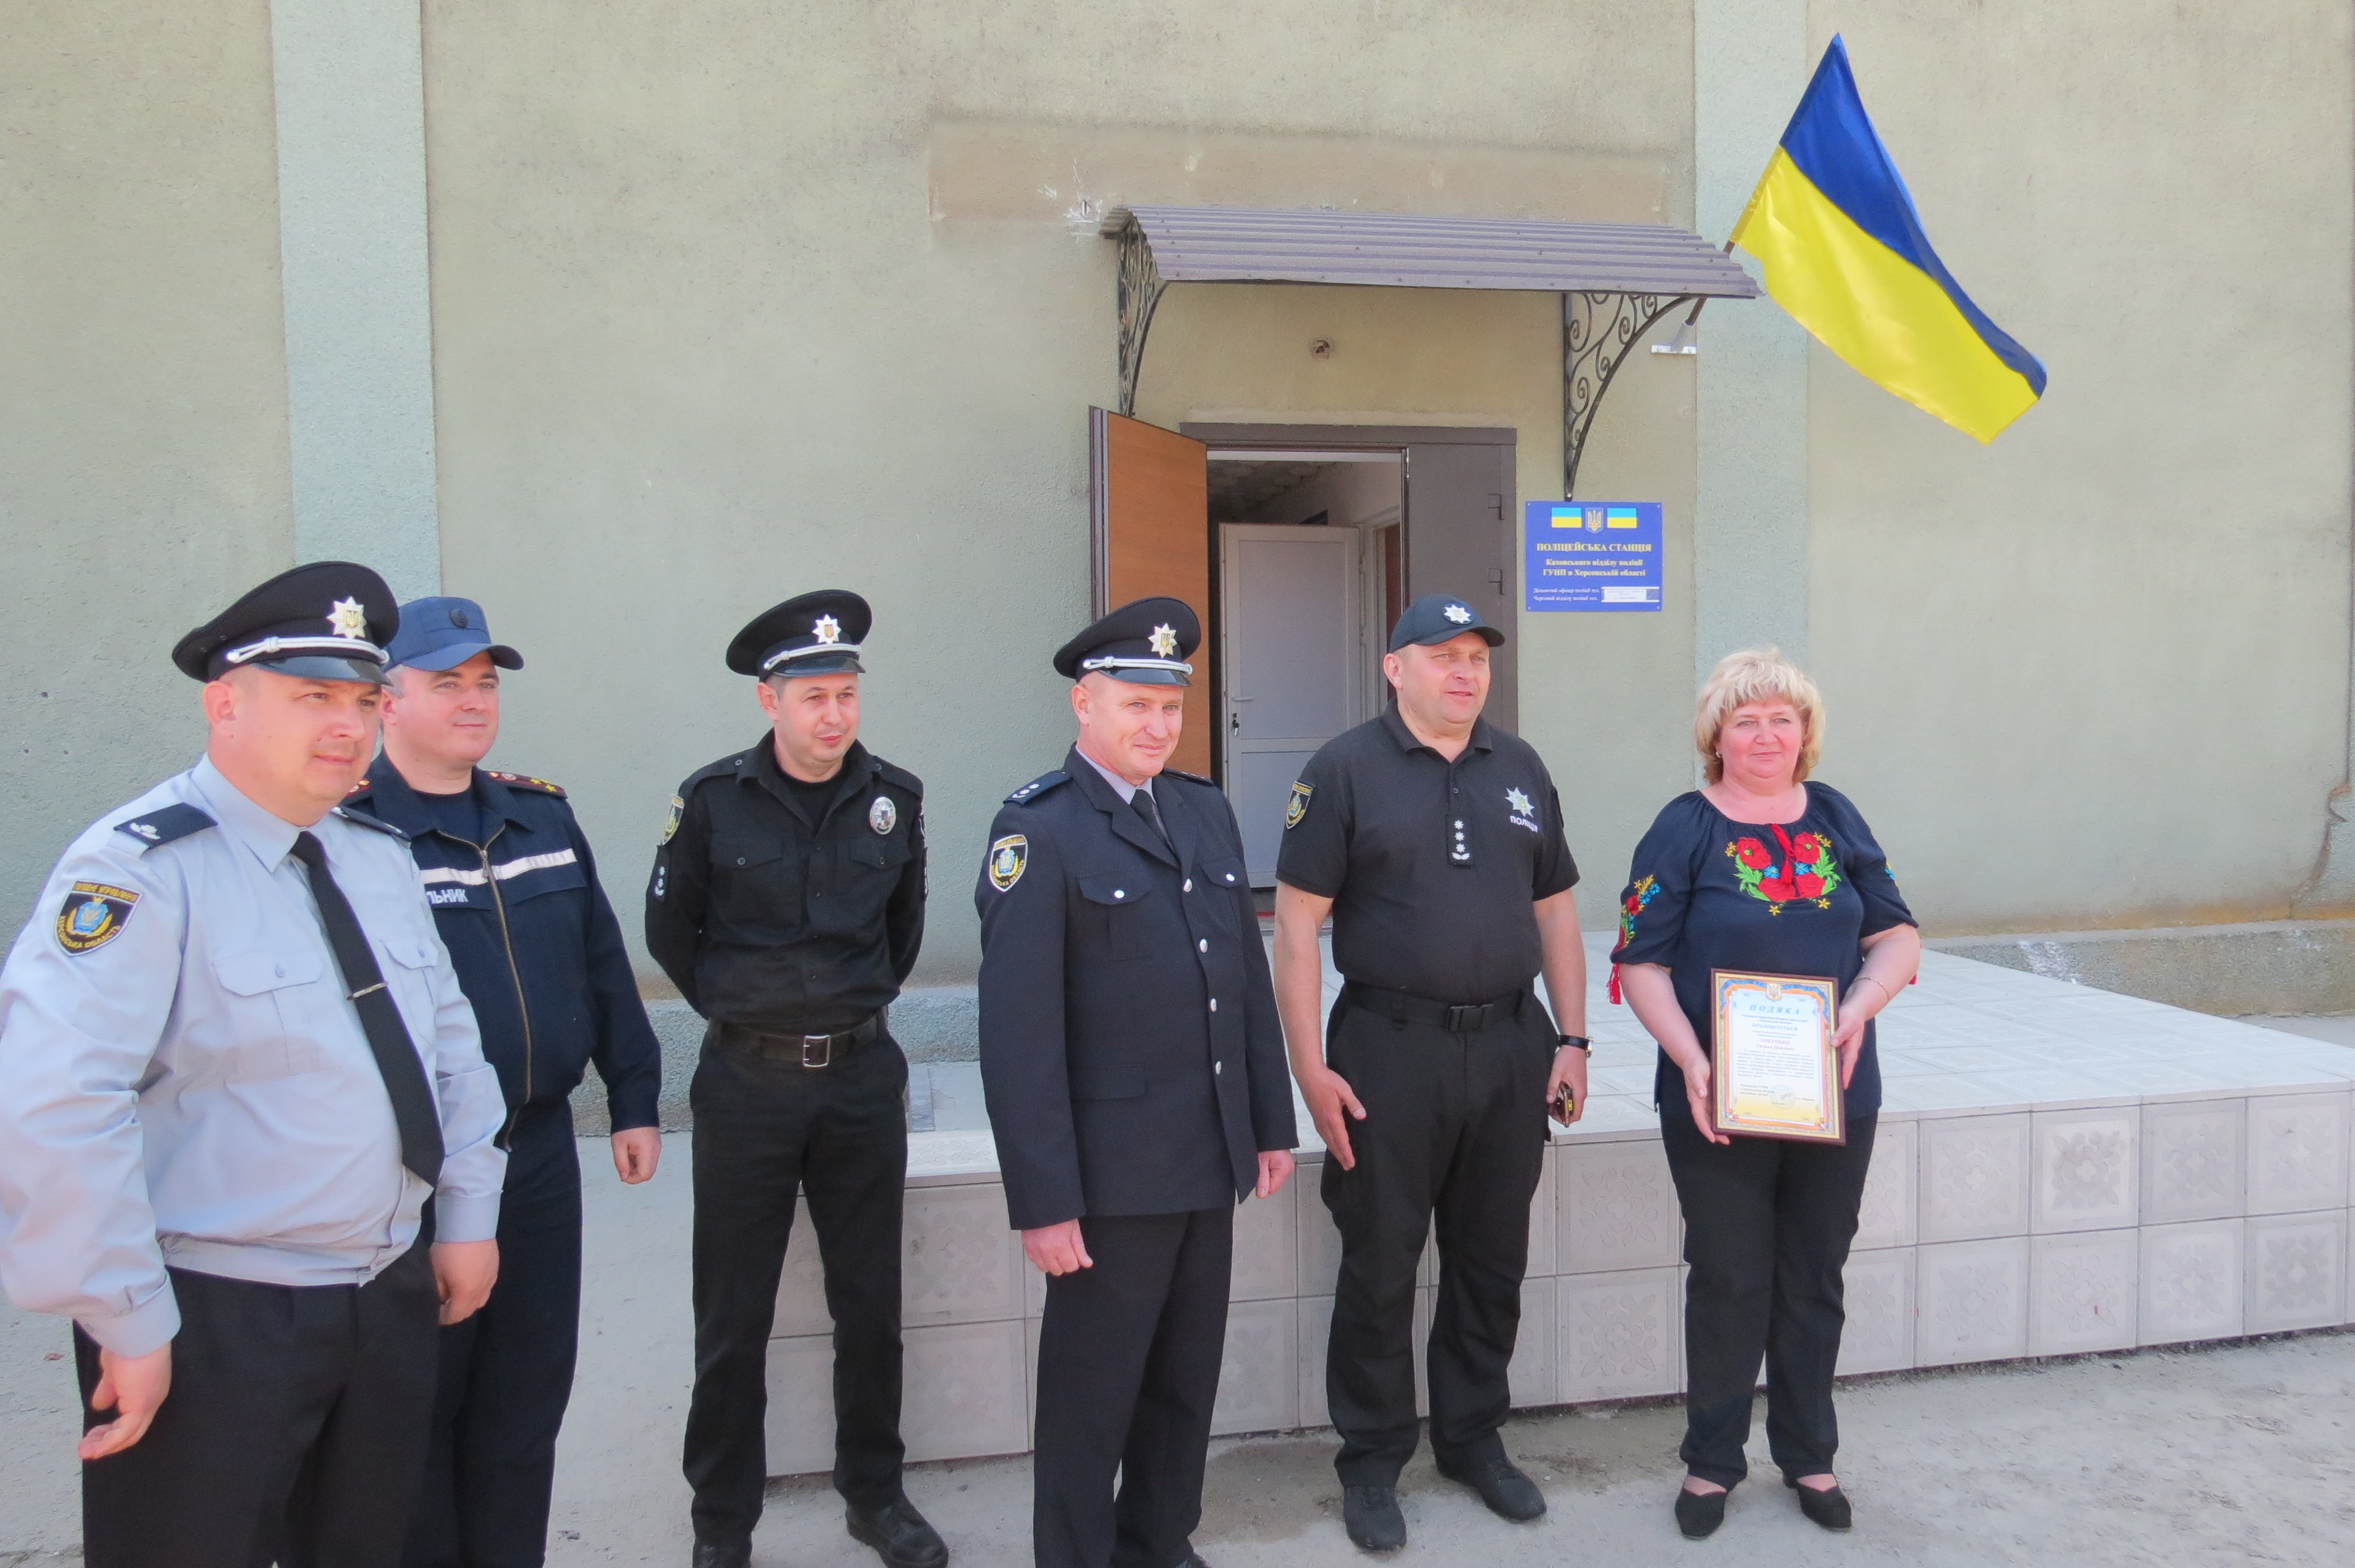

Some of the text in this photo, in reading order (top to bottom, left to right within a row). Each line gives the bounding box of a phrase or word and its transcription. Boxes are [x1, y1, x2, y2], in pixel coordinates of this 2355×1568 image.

[1537, 542, 1652, 552] ПОЛІЦЕЙСЬКА СТАНЦІЯ
[1593, 559, 1617, 567] відділу
[1574, 569, 1618, 577] Херсонській
[1510, 816, 1538, 833] ПОЛІЦІЯ
[85, 925, 121, 948] ОБЛАСТЬ
